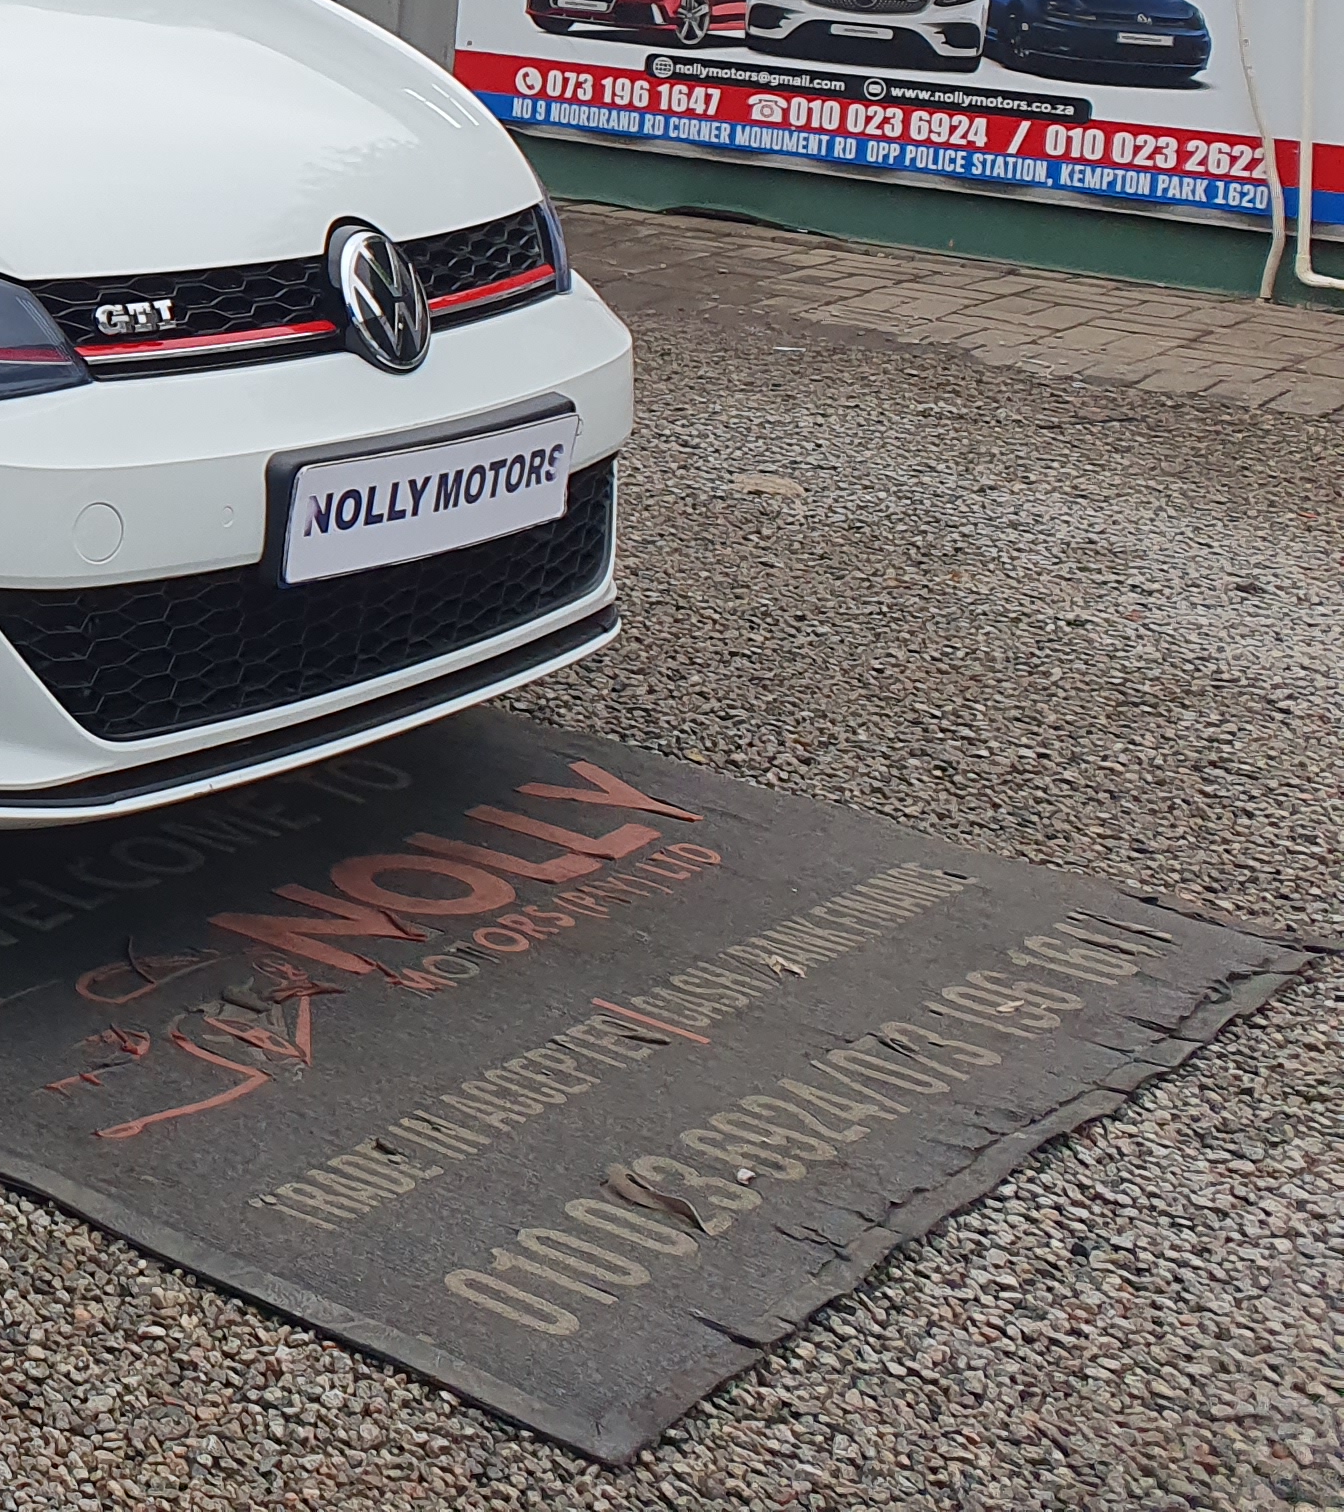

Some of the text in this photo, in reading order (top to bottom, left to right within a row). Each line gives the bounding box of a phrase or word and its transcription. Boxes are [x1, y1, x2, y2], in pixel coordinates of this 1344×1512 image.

[546, 70, 1268, 179] 073 196 1647 010 023 6924 / 010 023 2622
[675, 63, 1075, 116] nollymotors@gmail.com www.nollymotors.co.za
[512, 98, 1269, 209] NO 9 NOORDRAND RD CORNER MONUMENT RD OPP POLICE STATION, KEMPTON PARK 1620
[95, 299, 177, 335] GTI
[303, 443, 565, 537] NOLLY MOTORS
[278, 756, 414, 805] TO
[210, 760, 704, 975] NOLLY
[385, 905, 576, 998] MOTORS
[636, 842, 722, 880] LTD
[247, 1136, 444, 1231] TRADE
[387, 1109, 492, 1161] IN
[443, 1227, 652, 1336] 010
[922, 969, 1087, 1040] 196
